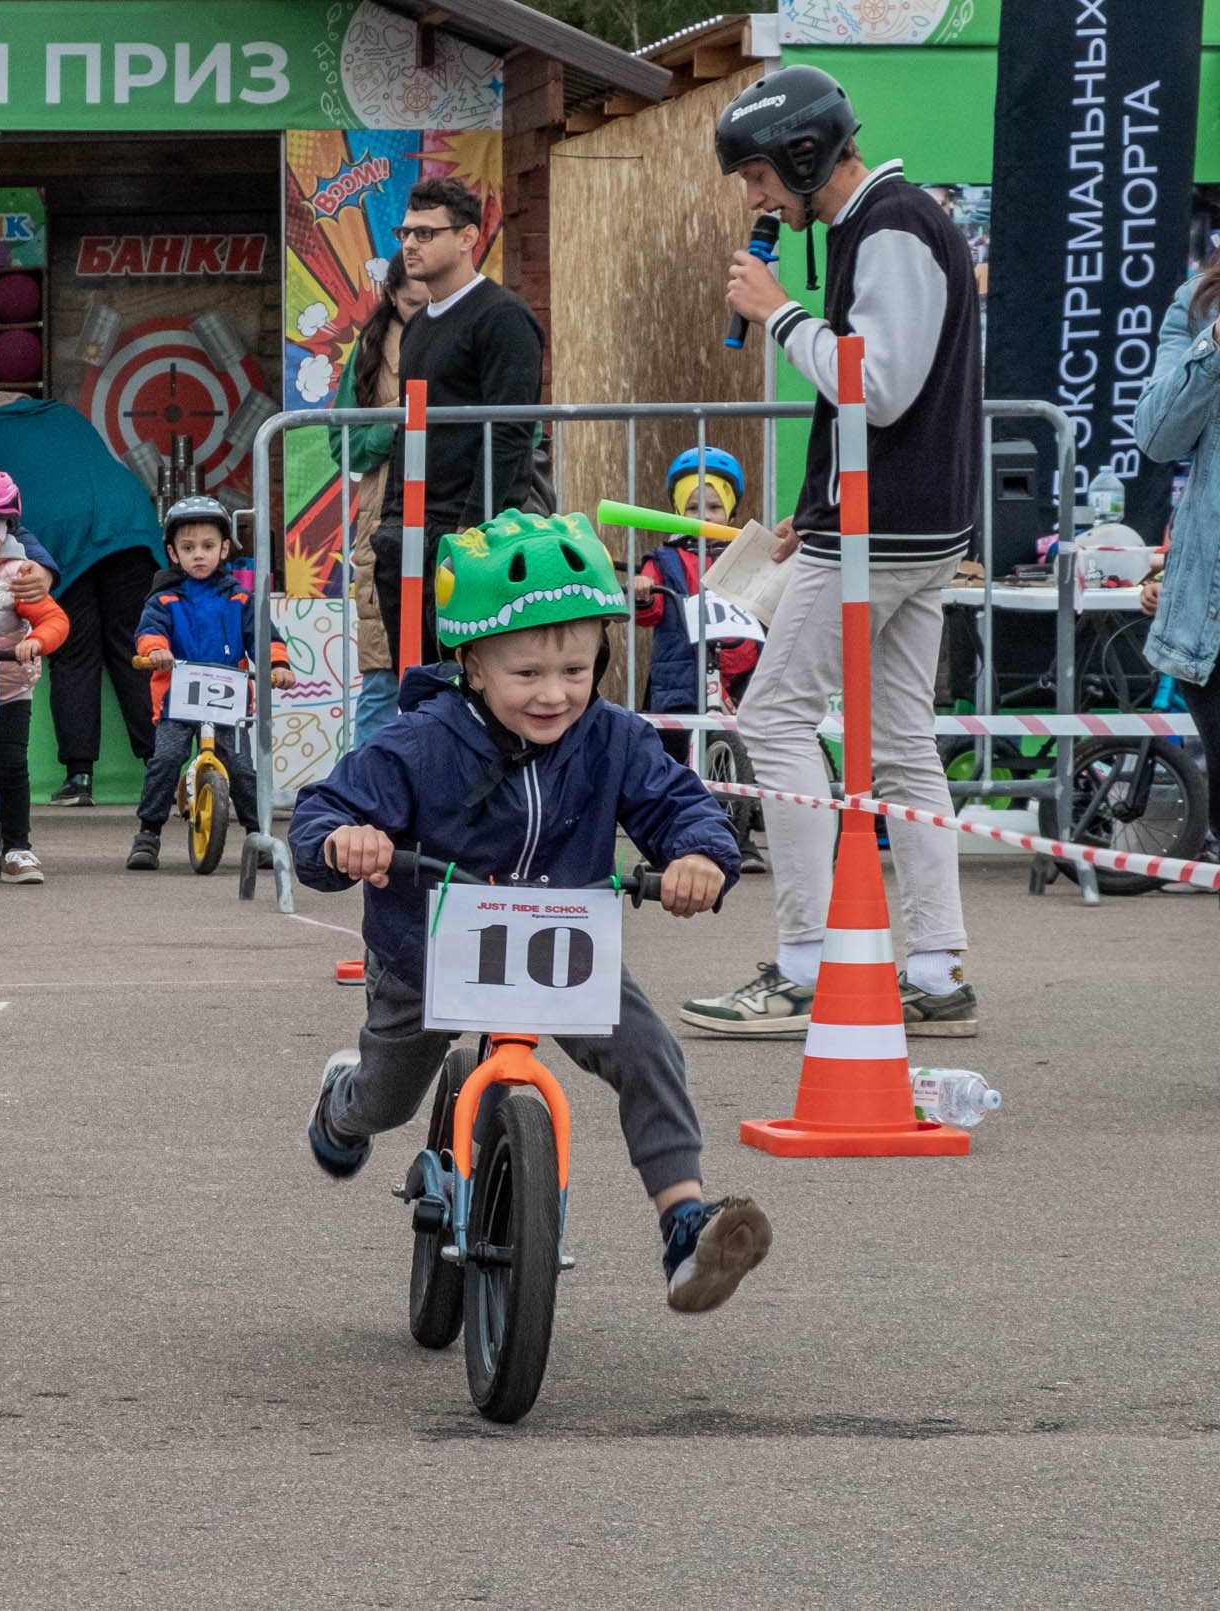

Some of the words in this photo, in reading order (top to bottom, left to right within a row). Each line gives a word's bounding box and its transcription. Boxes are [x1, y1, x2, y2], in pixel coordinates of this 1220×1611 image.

[45, 41, 291, 105] ПРИЗ
[312, 157, 390, 216] BOOM!!
[1121, 80, 1161, 289] СПОРТА
[76, 234, 267, 276] БАНКИ
[1109, 305, 1151, 479] ВИДОВ
[182, 680, 236, 711] 12
[477, 902, 507, 911] JUST
[512, 904, 540, 913] RIDE
[545, 905, 588, 914] SCHOOL
[464, 924, 594, 989] 10
